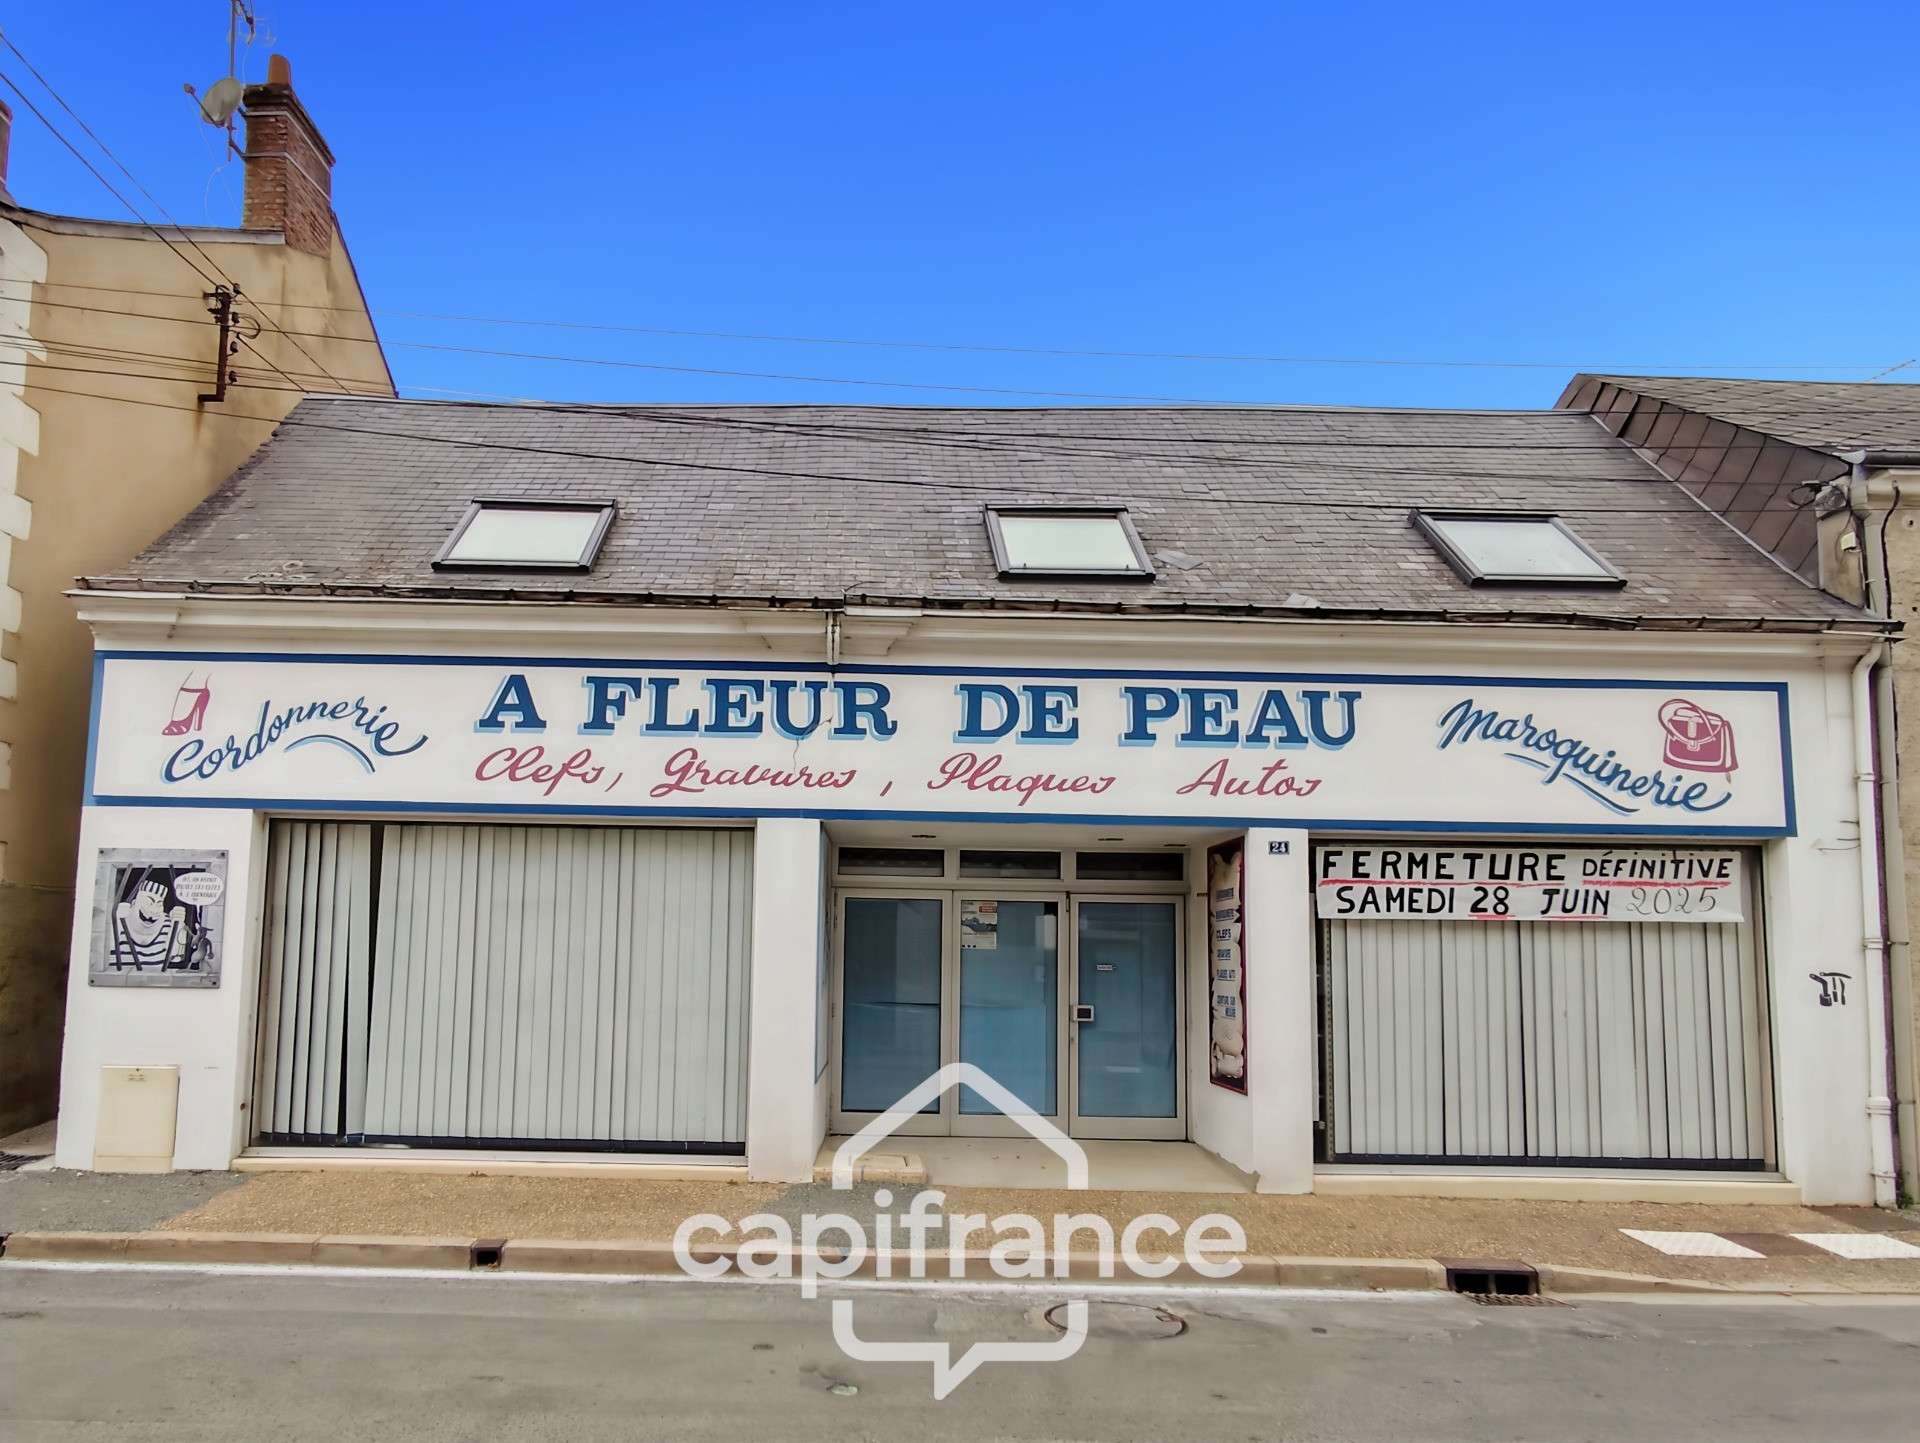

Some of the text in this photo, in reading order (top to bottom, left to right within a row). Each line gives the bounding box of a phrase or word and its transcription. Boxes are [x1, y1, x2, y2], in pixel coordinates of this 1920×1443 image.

[475, 673, 1362, 751] A FLEUR DE PEAU
[161, 695, 429, 784] Cordonnerie
[1437, 698, 1732, 812] Maroquinerie
[927, 752, 1116, 806] Plaques
[1176, 758, 1322, 797] Autos
[1271, 842, 1286, 853] 24
[1322, 850, 1733, 881] FERMETURE DÉFINITIVE
[1336, 886, 1718, 915] SAMEDI 28 JUIN 2025
